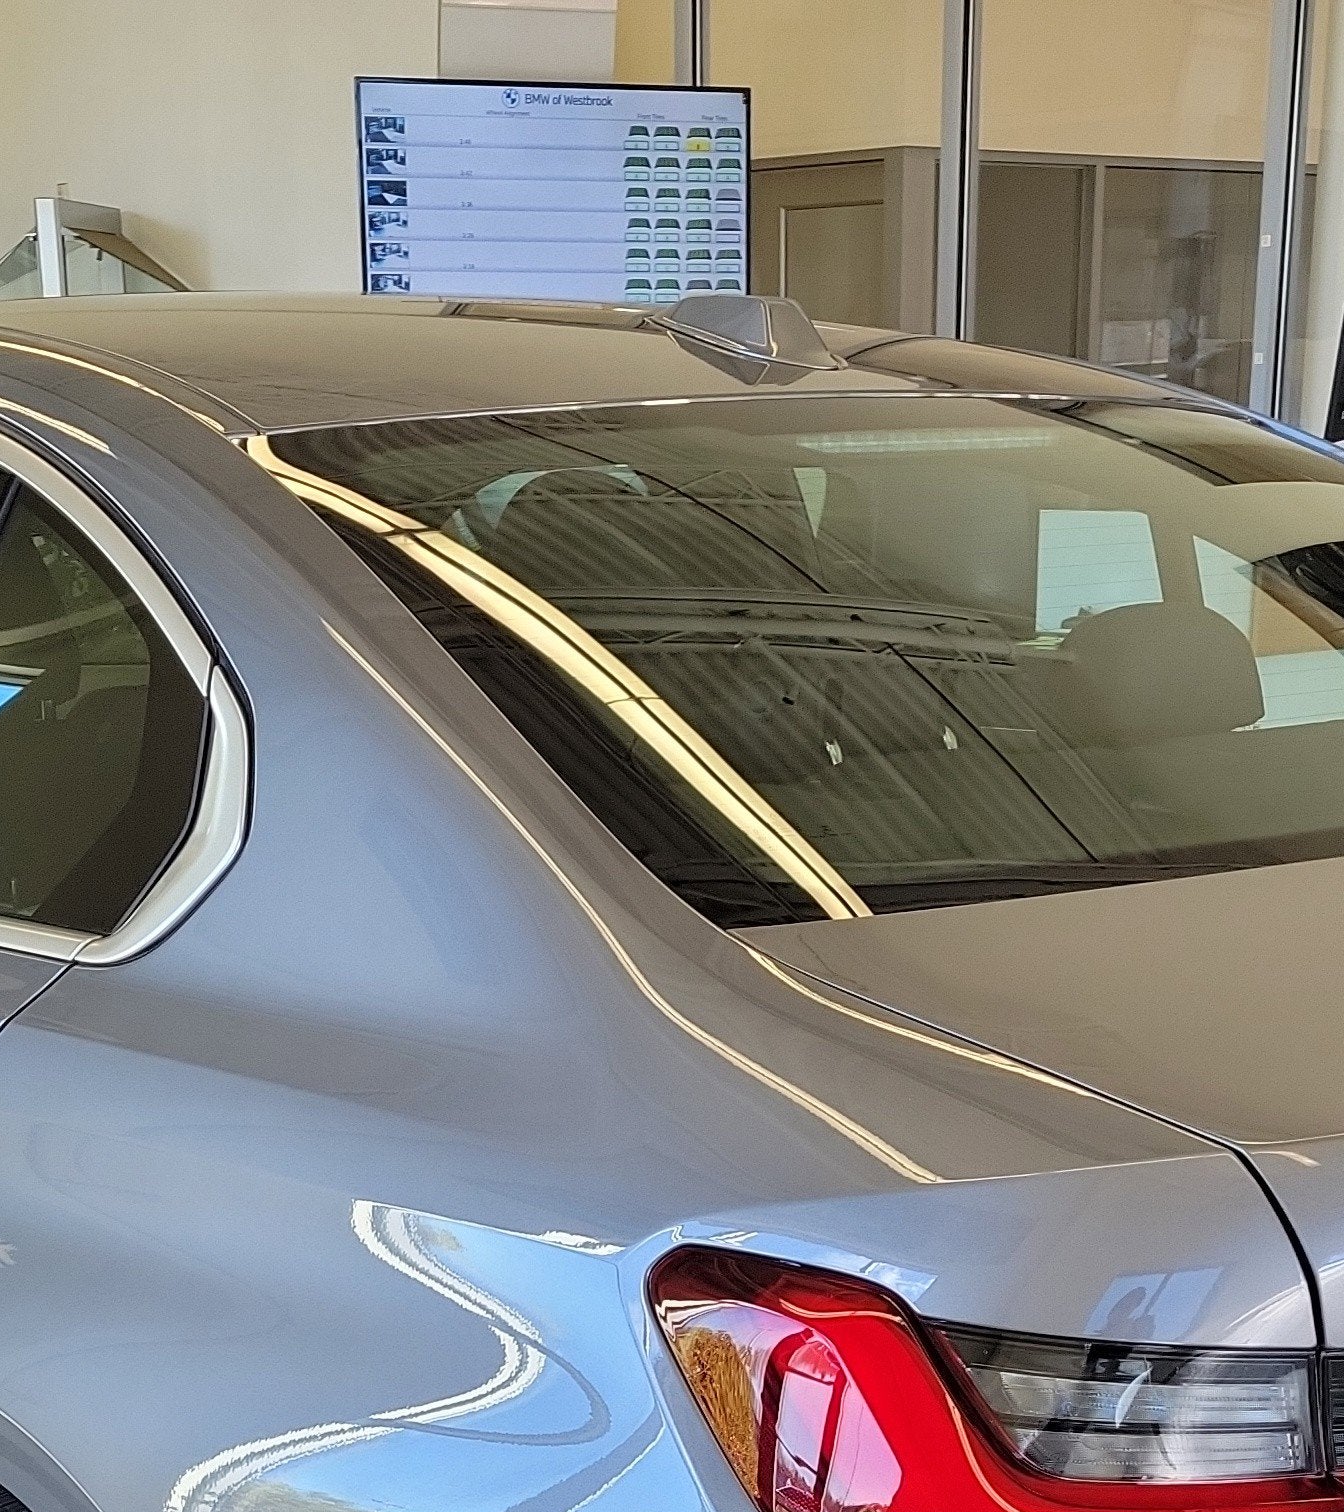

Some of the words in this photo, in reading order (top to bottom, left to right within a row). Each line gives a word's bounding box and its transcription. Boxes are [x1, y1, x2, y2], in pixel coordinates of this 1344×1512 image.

[524, 93, 550, 105] BMW
[552, 94, 561, 105] of
[562, 95, 613, 107] Westbrook
